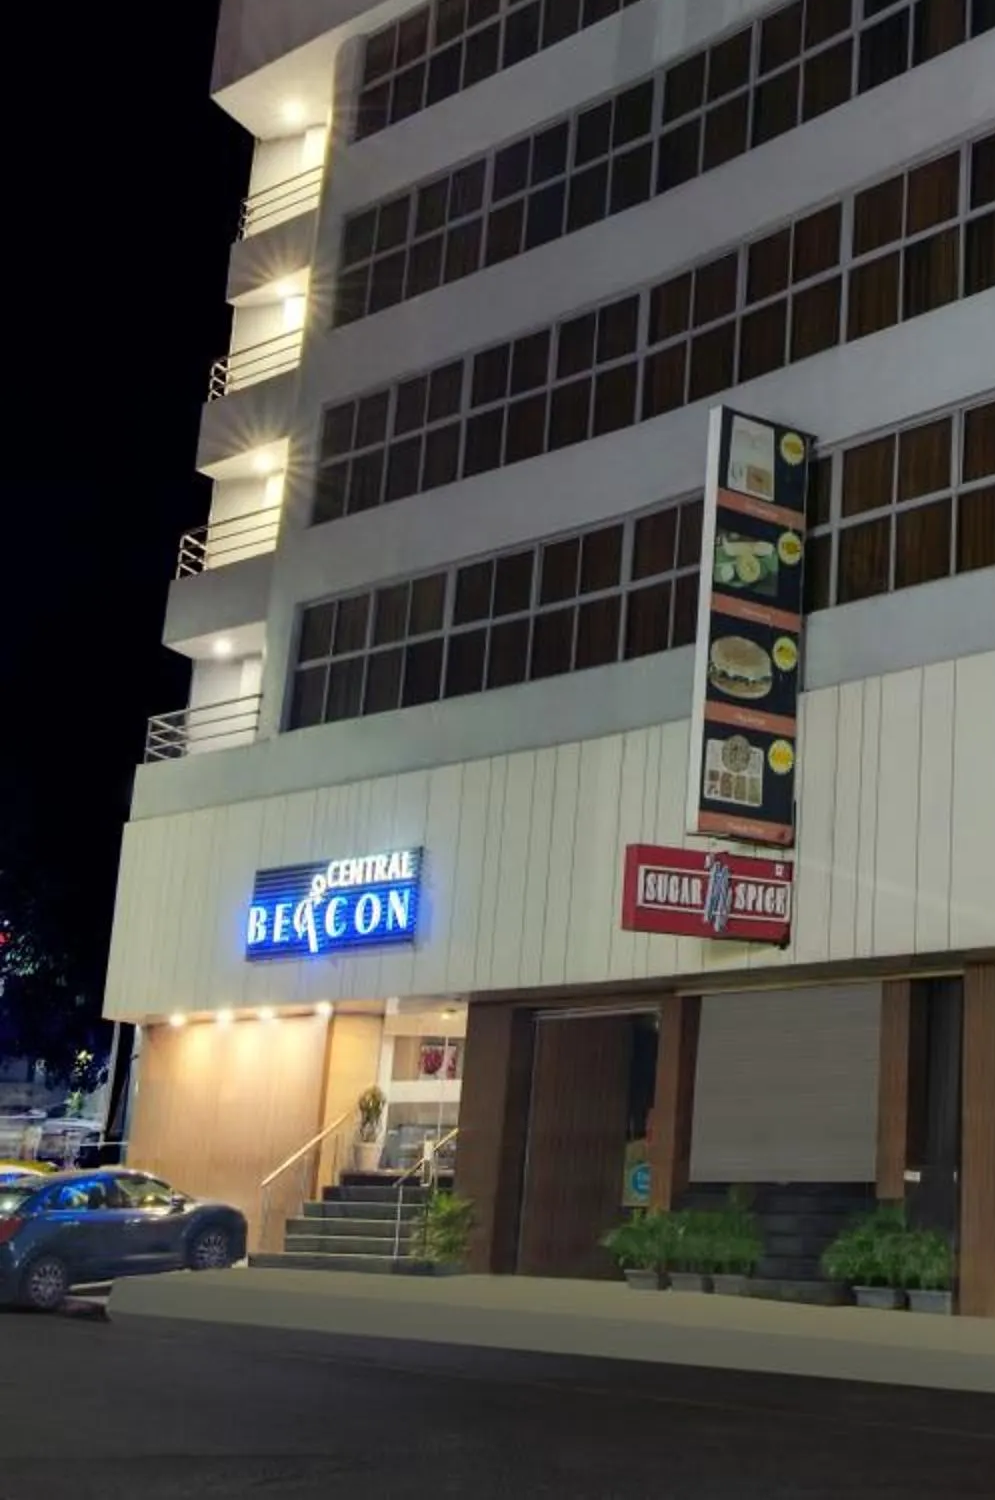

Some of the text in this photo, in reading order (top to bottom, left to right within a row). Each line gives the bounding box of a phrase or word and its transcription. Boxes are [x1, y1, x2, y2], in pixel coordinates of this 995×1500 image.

[327, 850, 413, 887] CENTRAL
[644, 871, 703, 906] SUGAR
[734, 881, 787, 916] SPICE
[246, 888, 411, 953] BEACON
